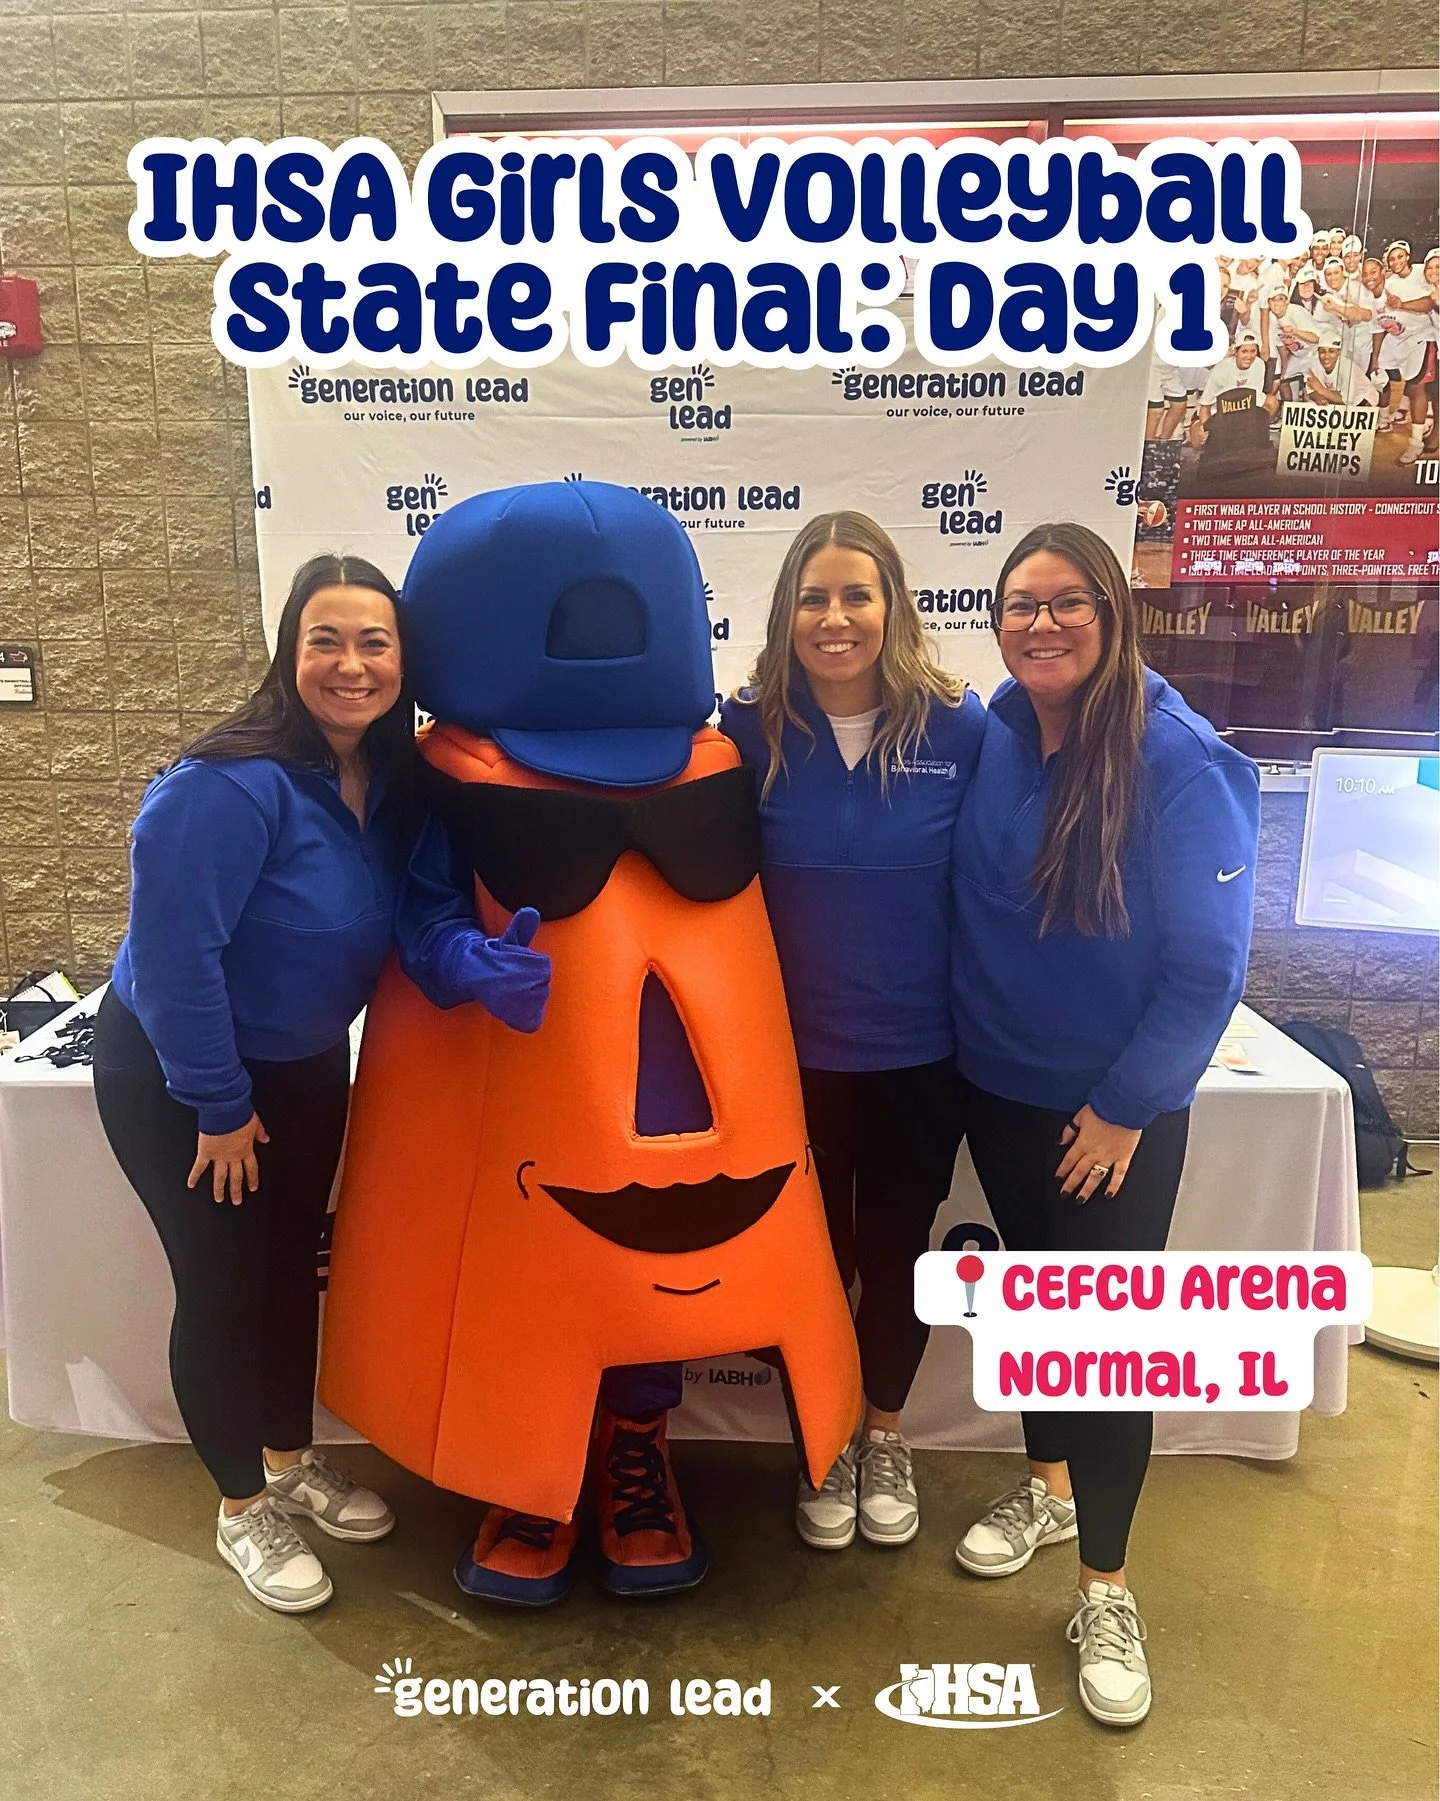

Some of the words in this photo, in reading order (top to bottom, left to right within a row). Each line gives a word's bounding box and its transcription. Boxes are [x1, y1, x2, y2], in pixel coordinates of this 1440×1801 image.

[301, 378, 453, 403] generation
[466, 378, 528, 402] lead
[650, 377, 703, 403] gen
[843, 372, 1005, 400] generation
[1018, 371, 1084, 397] lead
[886, 408, 908, 417] our
[913, 406, 951, 418] voice,
[956, 407, 978, 416] our
[982, 405, 1025, 416] future
[1222, 395, 1252, 413] VALLEY
[344, 412, 365, 421] our
[369, 410, 407, 422] voice,
[410, 412, 431, 421] our
[435, 410, 475, 421] future
[669, 405, 731, 429] lead
[1285, 407, 1376, 430] MISSOURI
[1293, 430, 1361, 451] VALLEY
[1286, 451, 1361, 476] CHAMPS
[387, 485, 437, 511] gen
[738, 486, 800, 511] lead
[922, 482, 974, 509] gen
[1194, 504, 1218, 515] FIRST
[1220, 504, 1245, 515] WNBA
[1247, 504, 1280, 515] PLAYER
[1282, 504, 1291, 515] IN
[1293, 503, 1327, 515] SCHOOL
[1330, 503, 1367, 515] HISTORY
[1375, 503, 1435, 514] CONNECTICUT
[407, 513, 443, 537] le
[680, 520, 701, 528] our
[705, 518, 745, 528] future
[940, 510, 1002, 535] lead
[1193, 519, 1211, 531] TWO
[1214, 519, 1233, 531] TIME
[1235, 519, 1247, 531] AP
[1249, 519, 1312, 531] ALL-AMERICAN
[1192, 535, 1210, 546] TWO
[1213, 535, 1232, 546] TIME
[1234, 535, 1258, 546] WBCA
[1261, 534, 1323, 546] ALL-AMERICAN
[1190, 550, 1216, 560] THREE
[1219, 550, 1238, 560] TIME
[1240, 550, 1294, 560] CONFERENCE
[1296, 550, 1329, 560] PLAYER
[1331, 549, 1342, 560] OF
[1344, 549, 1360, 560] THE
[1363, 549, 1385, 560] YEAR
[1408, 564, 1429, 576] FREE
[910, 588, 993, 613] ation
[944, 622, 967, 630] our
[1142, 601, 1212, 635] VALLEY
[1246, 600, 1320, 634] VALLEY
[1350, 600, 1424, 634] VALLEY
[1336, 777, 1376, 794] 10:10
[684, 1368, 703, 1384] by
[709, 1368, 754, 1386] IABH
